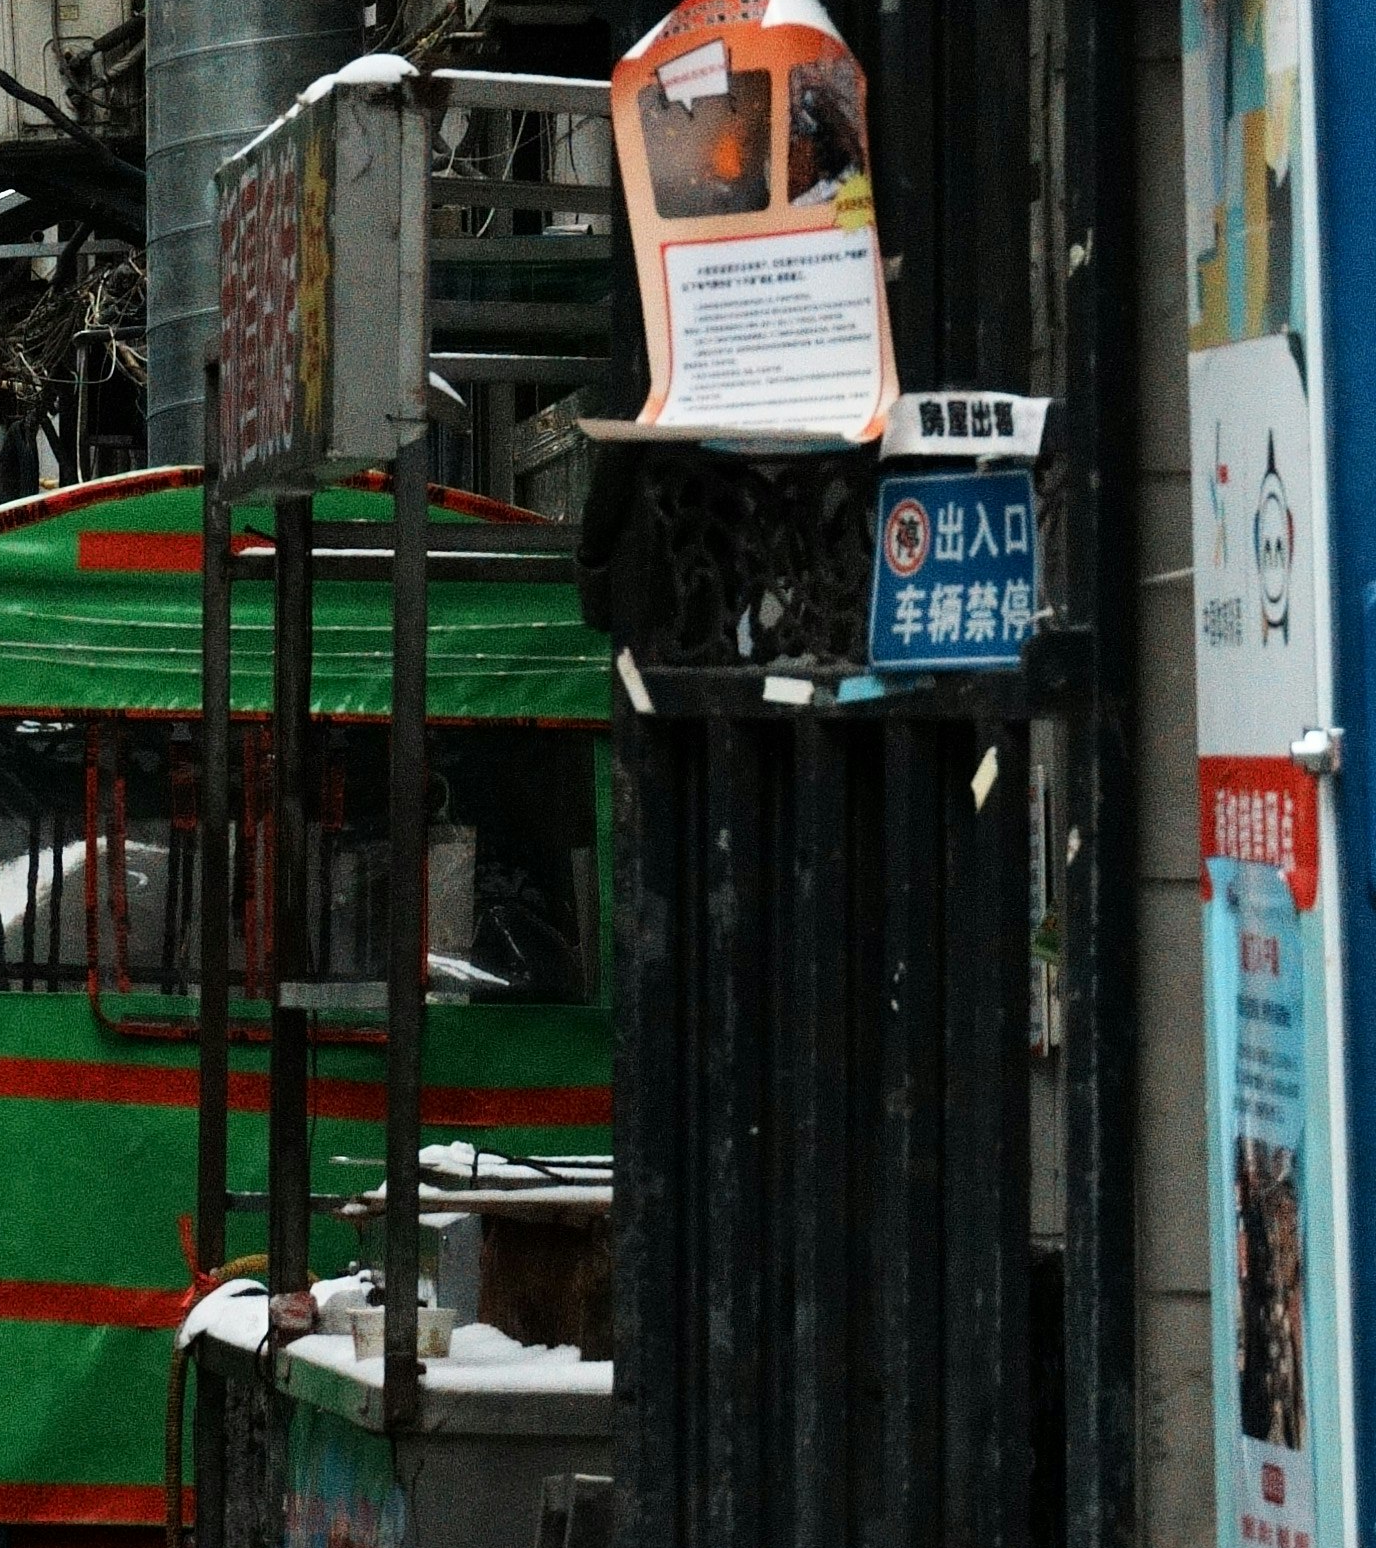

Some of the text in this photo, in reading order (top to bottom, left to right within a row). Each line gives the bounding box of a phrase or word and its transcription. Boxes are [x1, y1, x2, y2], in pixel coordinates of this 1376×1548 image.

[934, 501, 1029, 563] 出入口
[890, 576, 1033, 646] 车辆禁停
